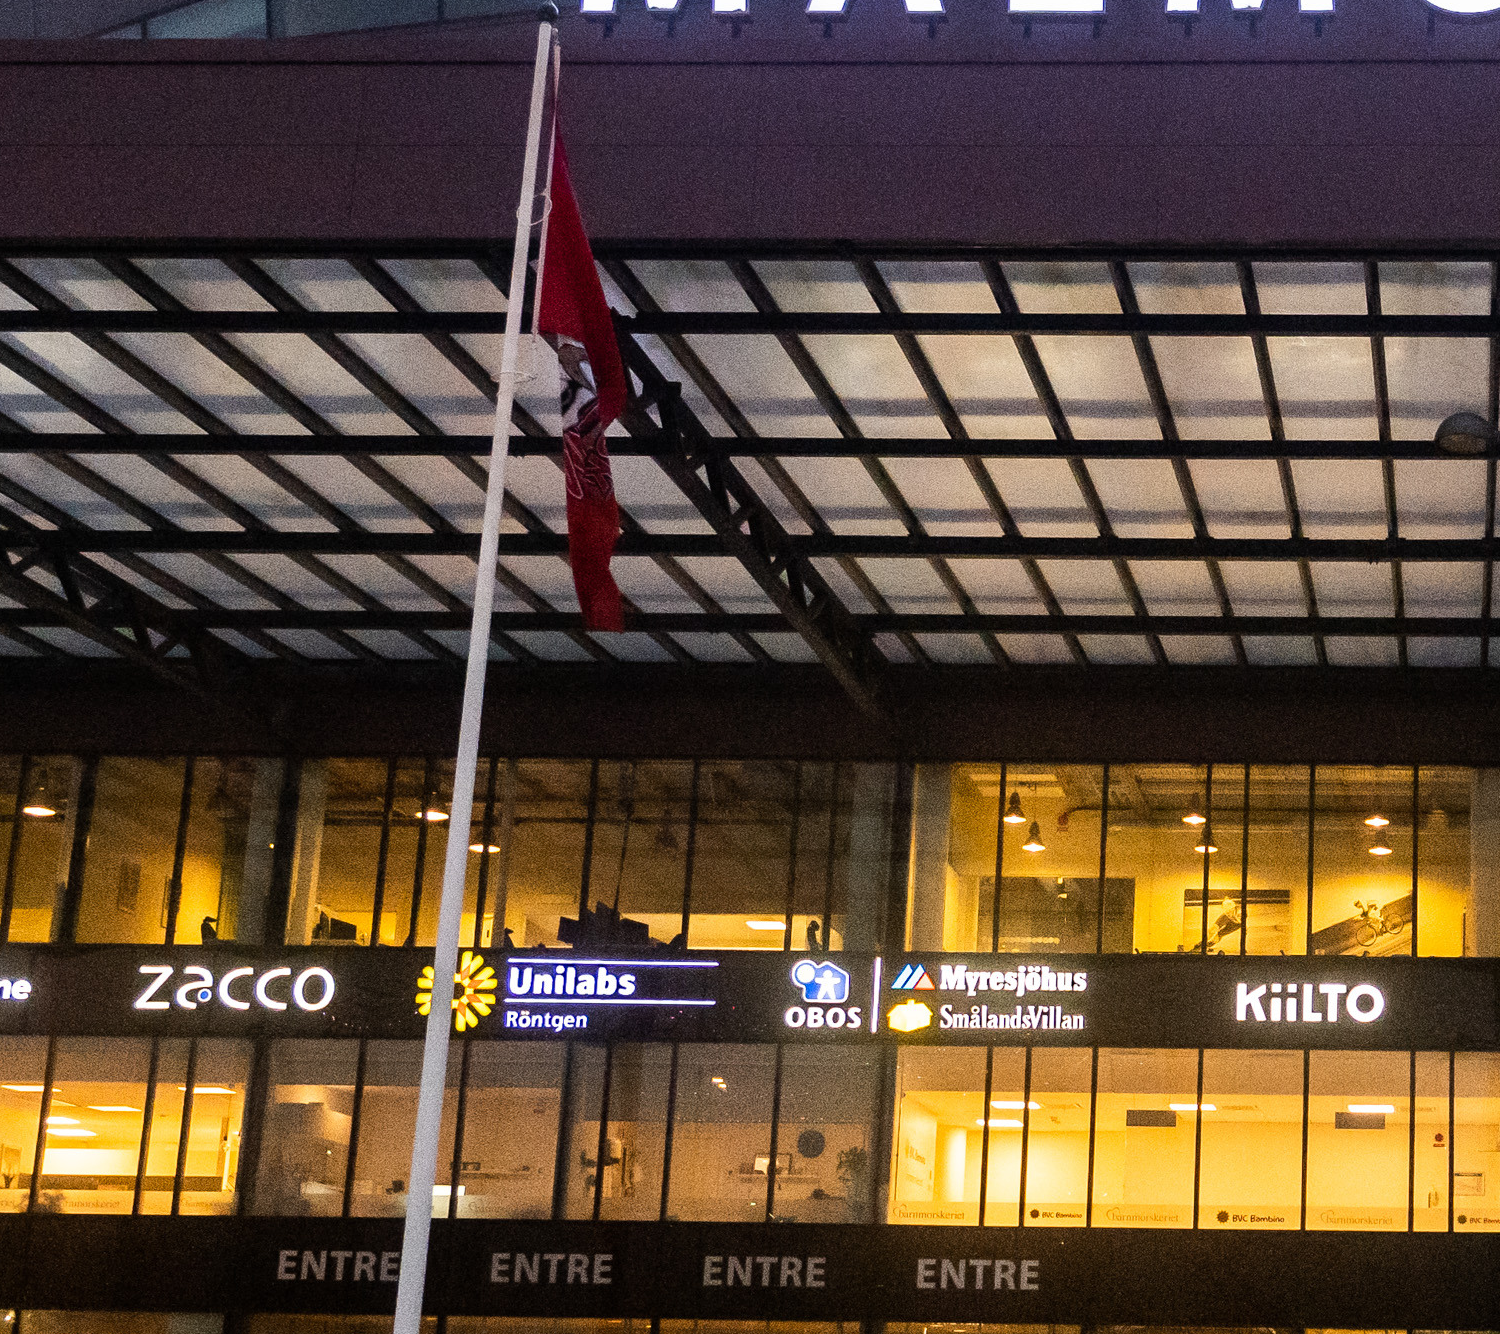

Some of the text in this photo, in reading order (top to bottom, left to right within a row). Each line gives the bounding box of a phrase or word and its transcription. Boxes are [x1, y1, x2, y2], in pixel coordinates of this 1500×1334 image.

[508, 965, 637, 997] Unilabs
[938, 962, 1088, 994] Myresjöhus
[504, 1008, 588, 1032] Röntgen
[783, 1005, 862, 1030] OBOS
[938, 1002, 1085, 1031] SmålandsVillan
[1232, 1215, 1285, 1223] BVC Bambino
[277, 1249, 400, 1283] ENTRE
[489, 1252, 613, 1286] ENTRE
[702, 1254, 827, 1289] ENTRE
[916, 1257, 1040, 1292] ENTRE
